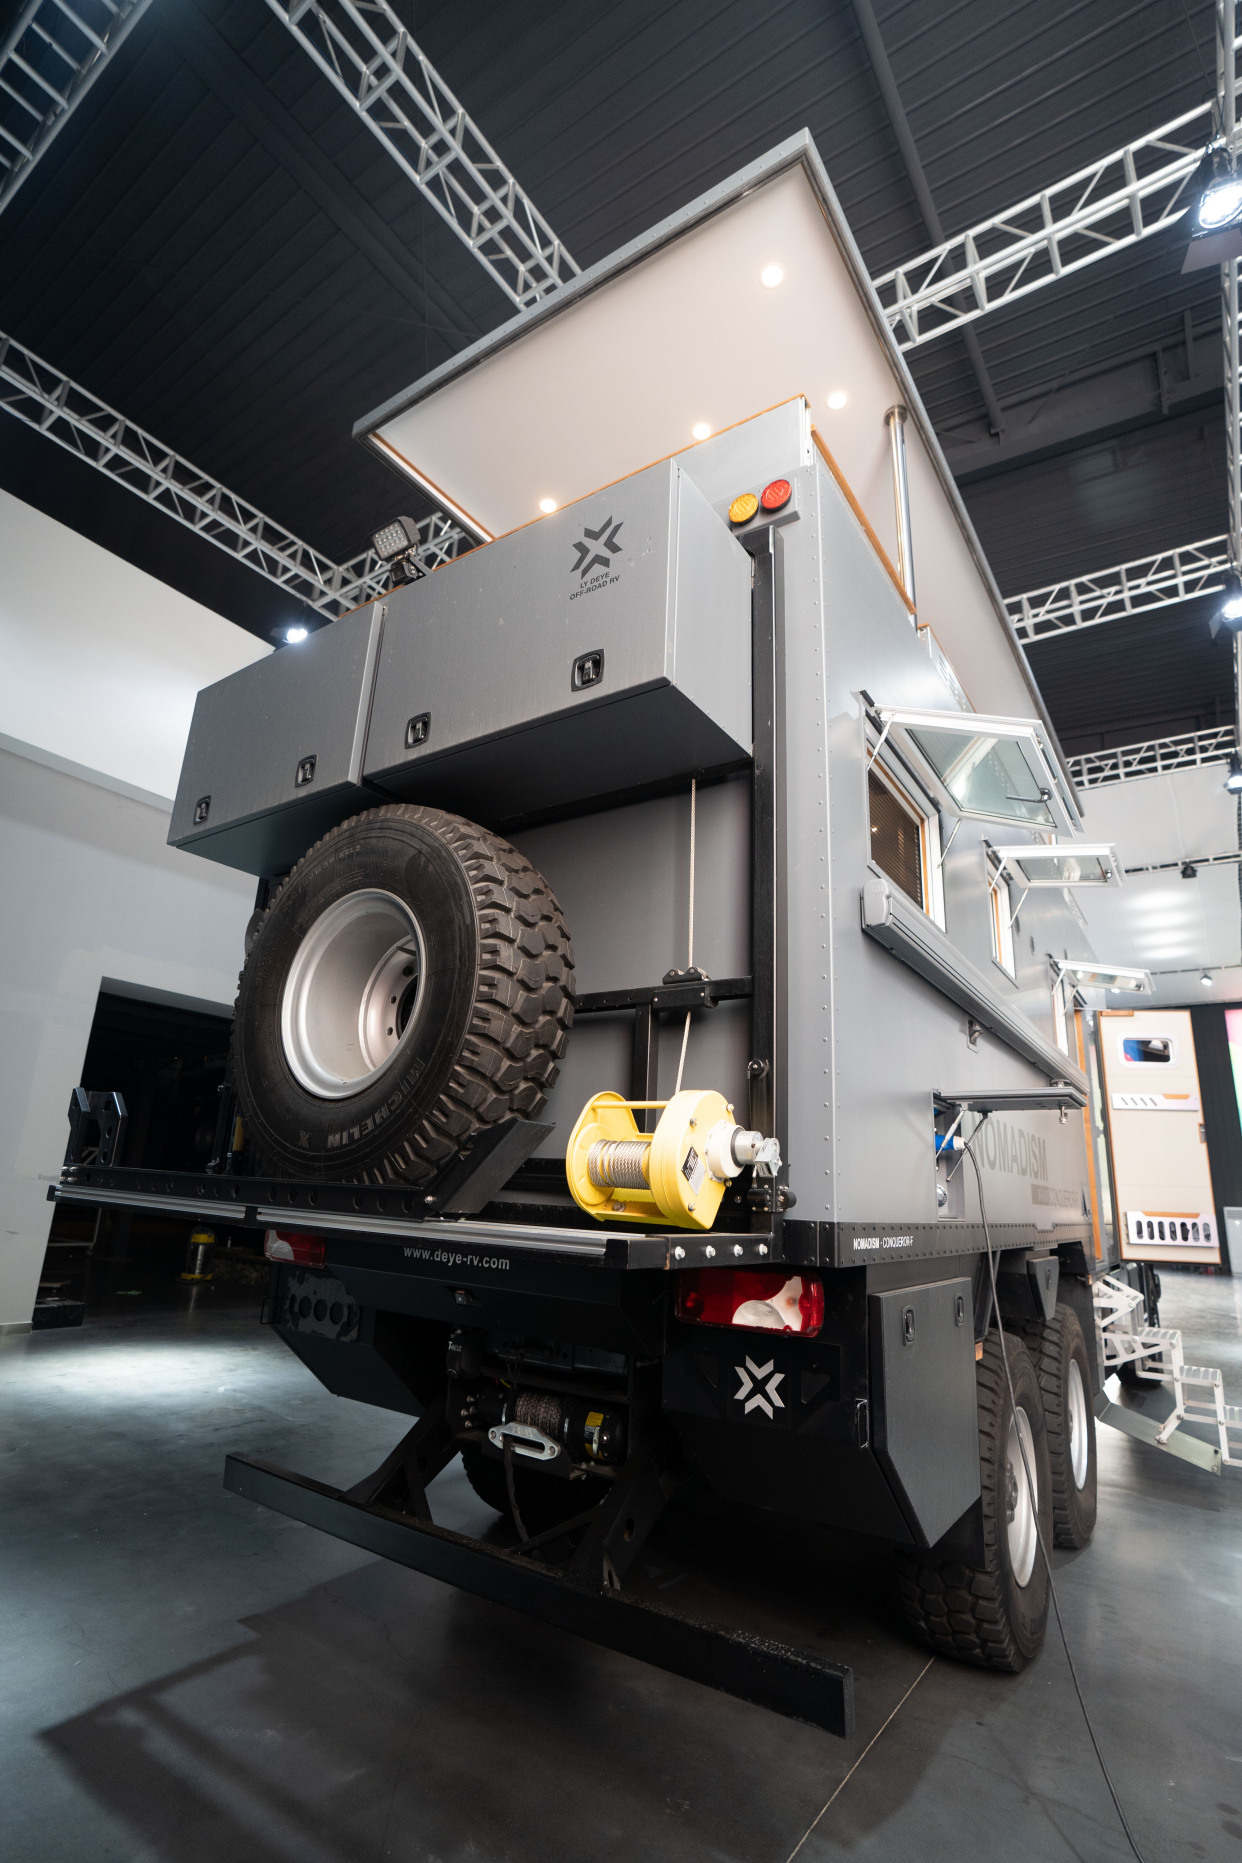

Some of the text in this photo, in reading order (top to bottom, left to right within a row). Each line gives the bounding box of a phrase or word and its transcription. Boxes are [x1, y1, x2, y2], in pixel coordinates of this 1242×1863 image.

[569, 574, 620, 601] OFF-ROAD RV
[580, 571, 610, 589] LY DEYE
[326, 1057, 425, 1149] MICHELIN
[853, 1237, 880, 1250] NOMADISM
[403, 1246, 510, 1270] www.deye-rv.com
